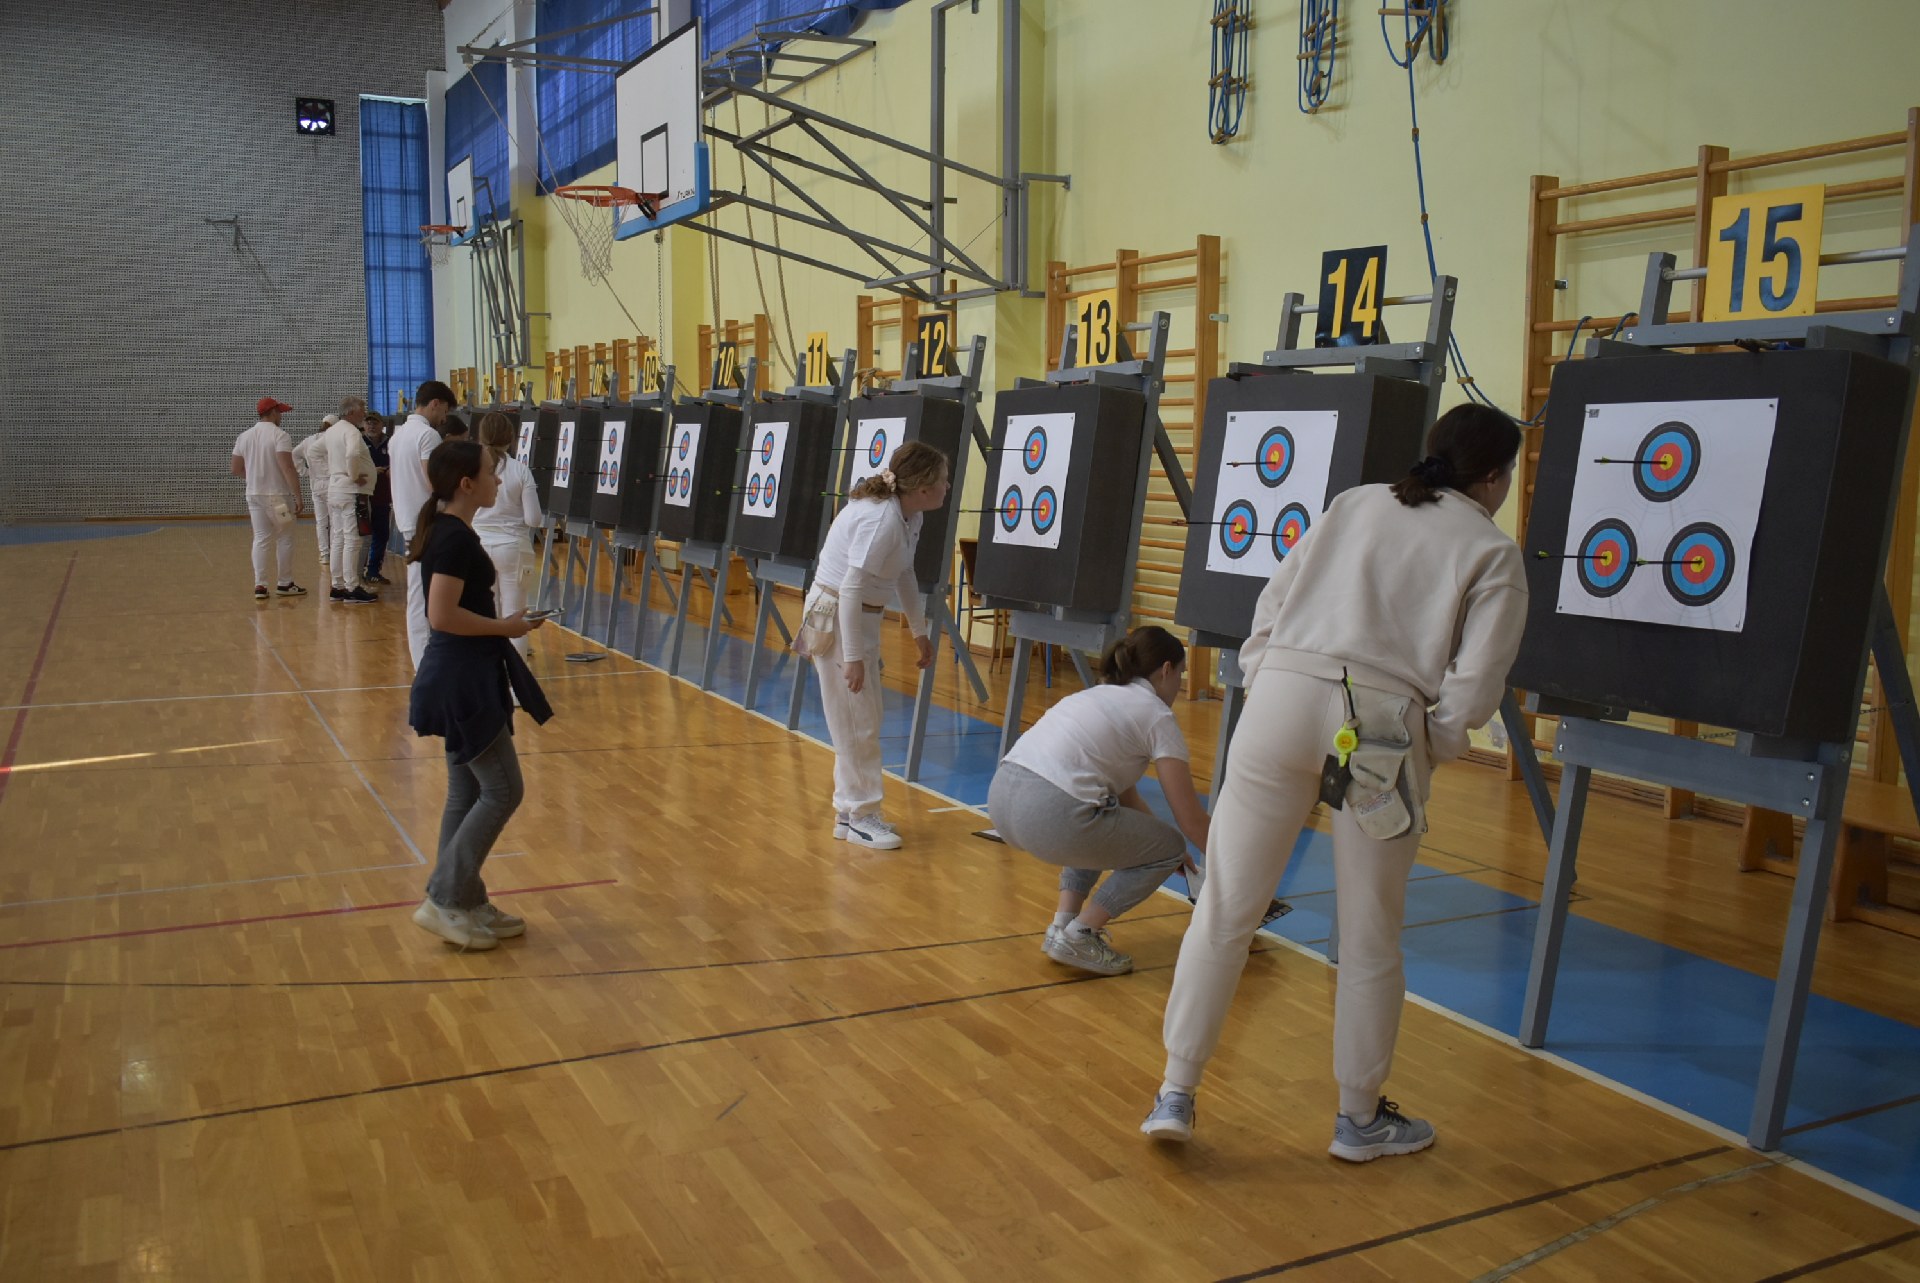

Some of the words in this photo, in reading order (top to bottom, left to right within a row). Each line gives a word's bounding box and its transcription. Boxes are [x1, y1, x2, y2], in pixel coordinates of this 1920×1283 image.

[1720, 203, 1803, 313] 15
[1327, 257, 1379, 338] 14
[920, 321, 945, 375] 12
[1081, 299, 1111, 365] 13
[644, 355, 657, 391] 09
[718, 346, 735, 387] 10
[808, 338, 824, 384] 11
